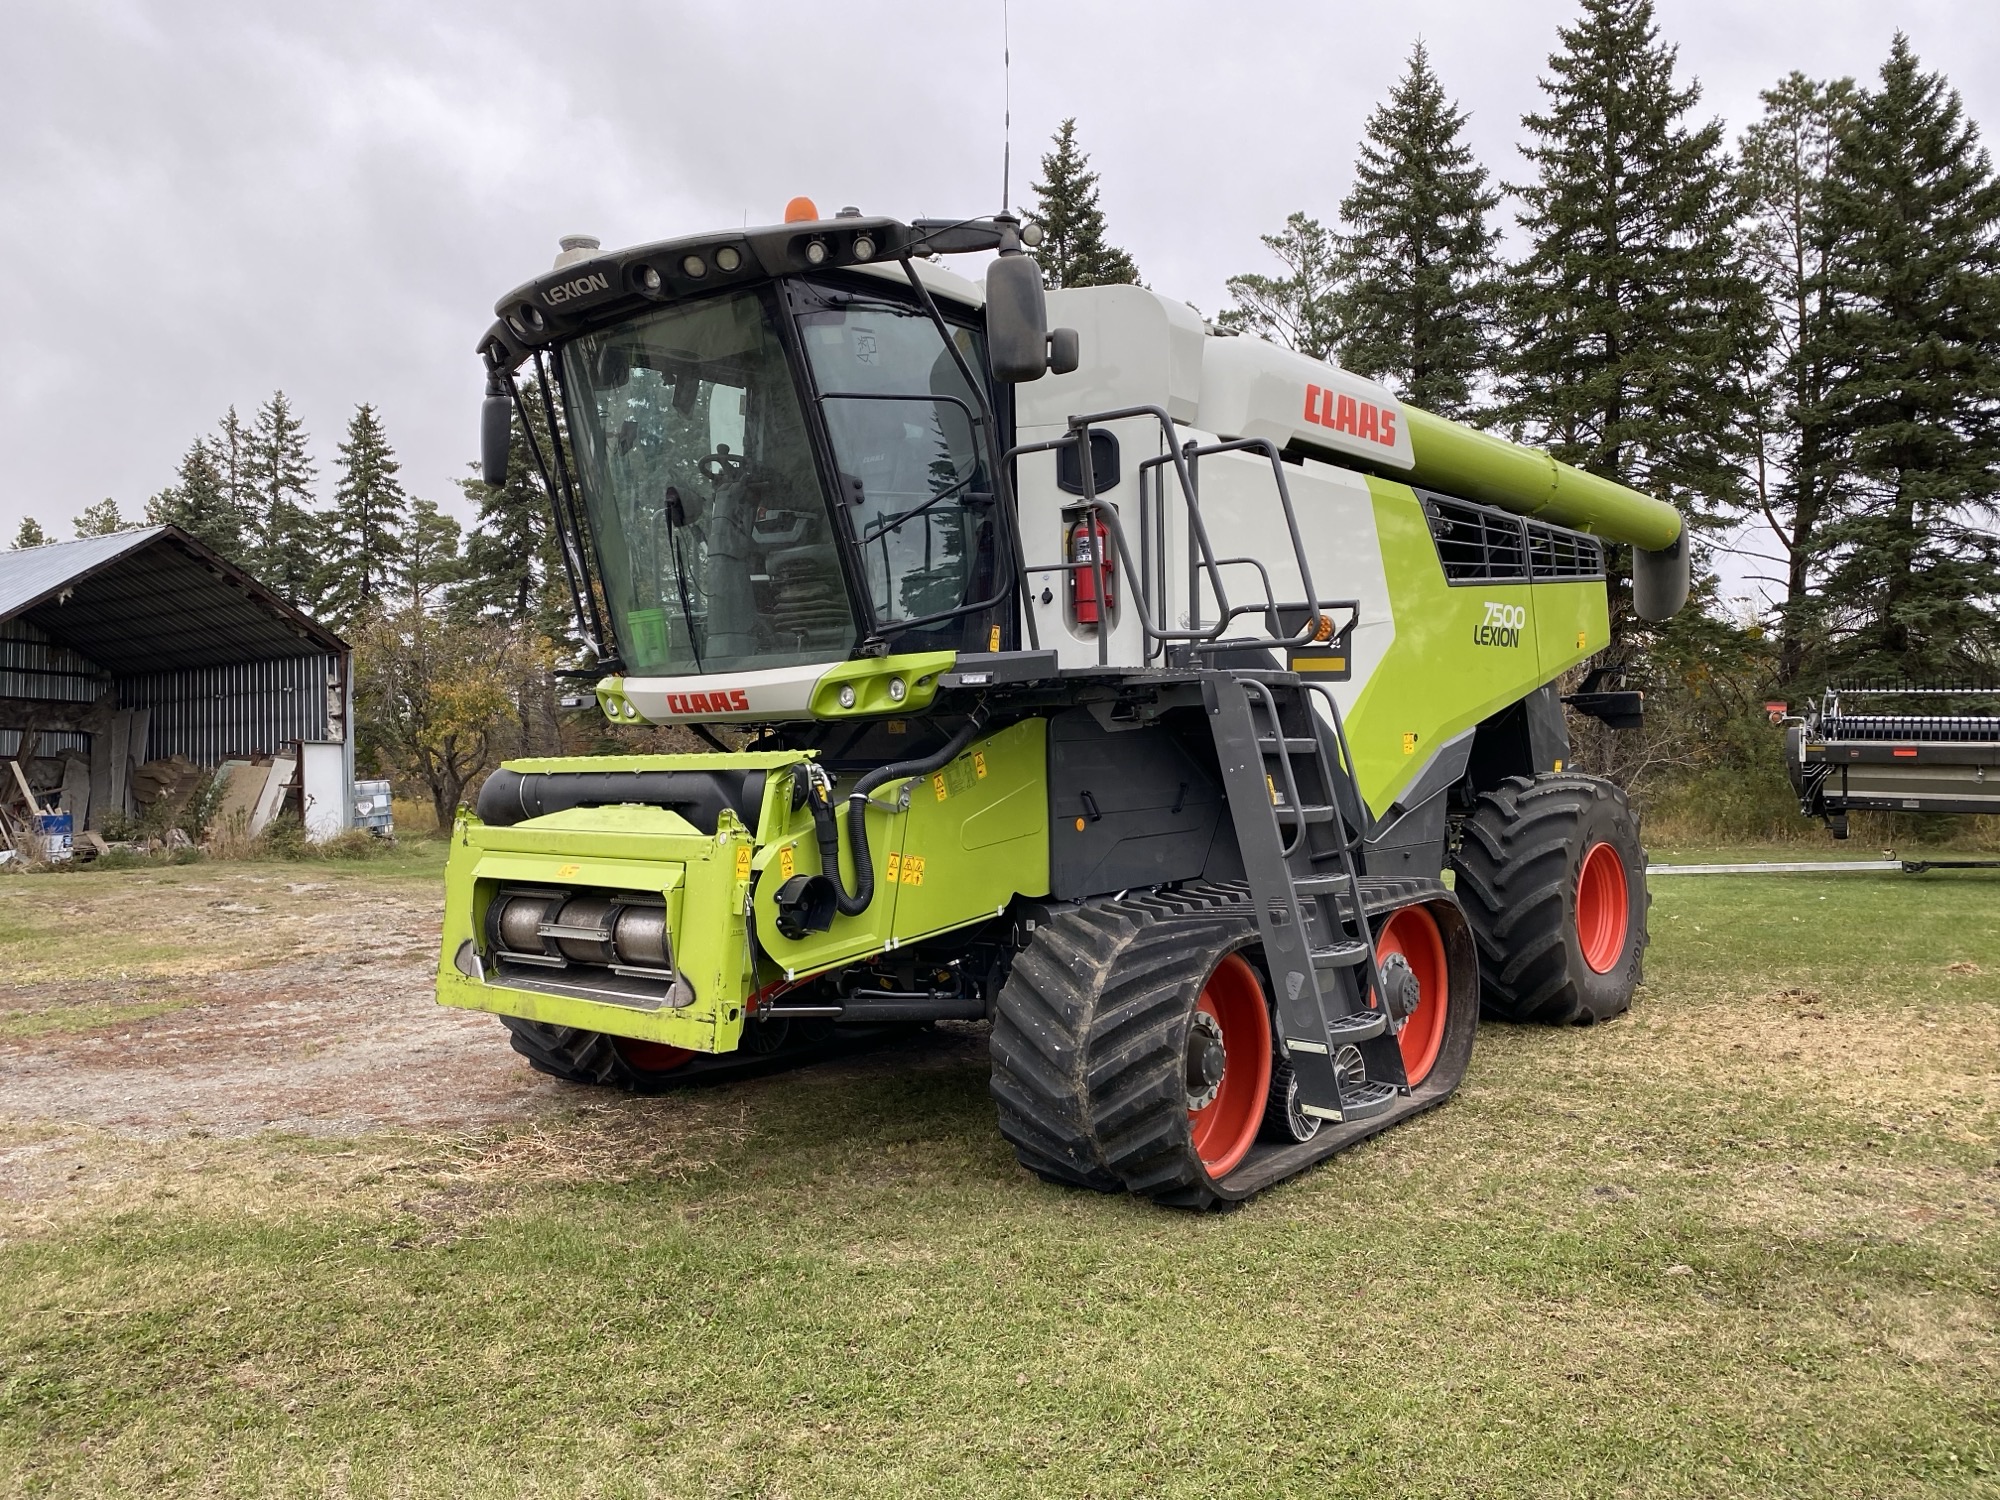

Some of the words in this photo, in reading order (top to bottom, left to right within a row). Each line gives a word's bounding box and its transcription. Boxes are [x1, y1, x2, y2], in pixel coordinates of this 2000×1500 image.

[541, 272, 609, 306] LEXION
[1304, 383, 1396, 447] CLAAS
[1483, 601, 1526, 630] 7500
[1473, 624, 1520, 648] LEXION
[666, 689, 750, 714] CLAAS
